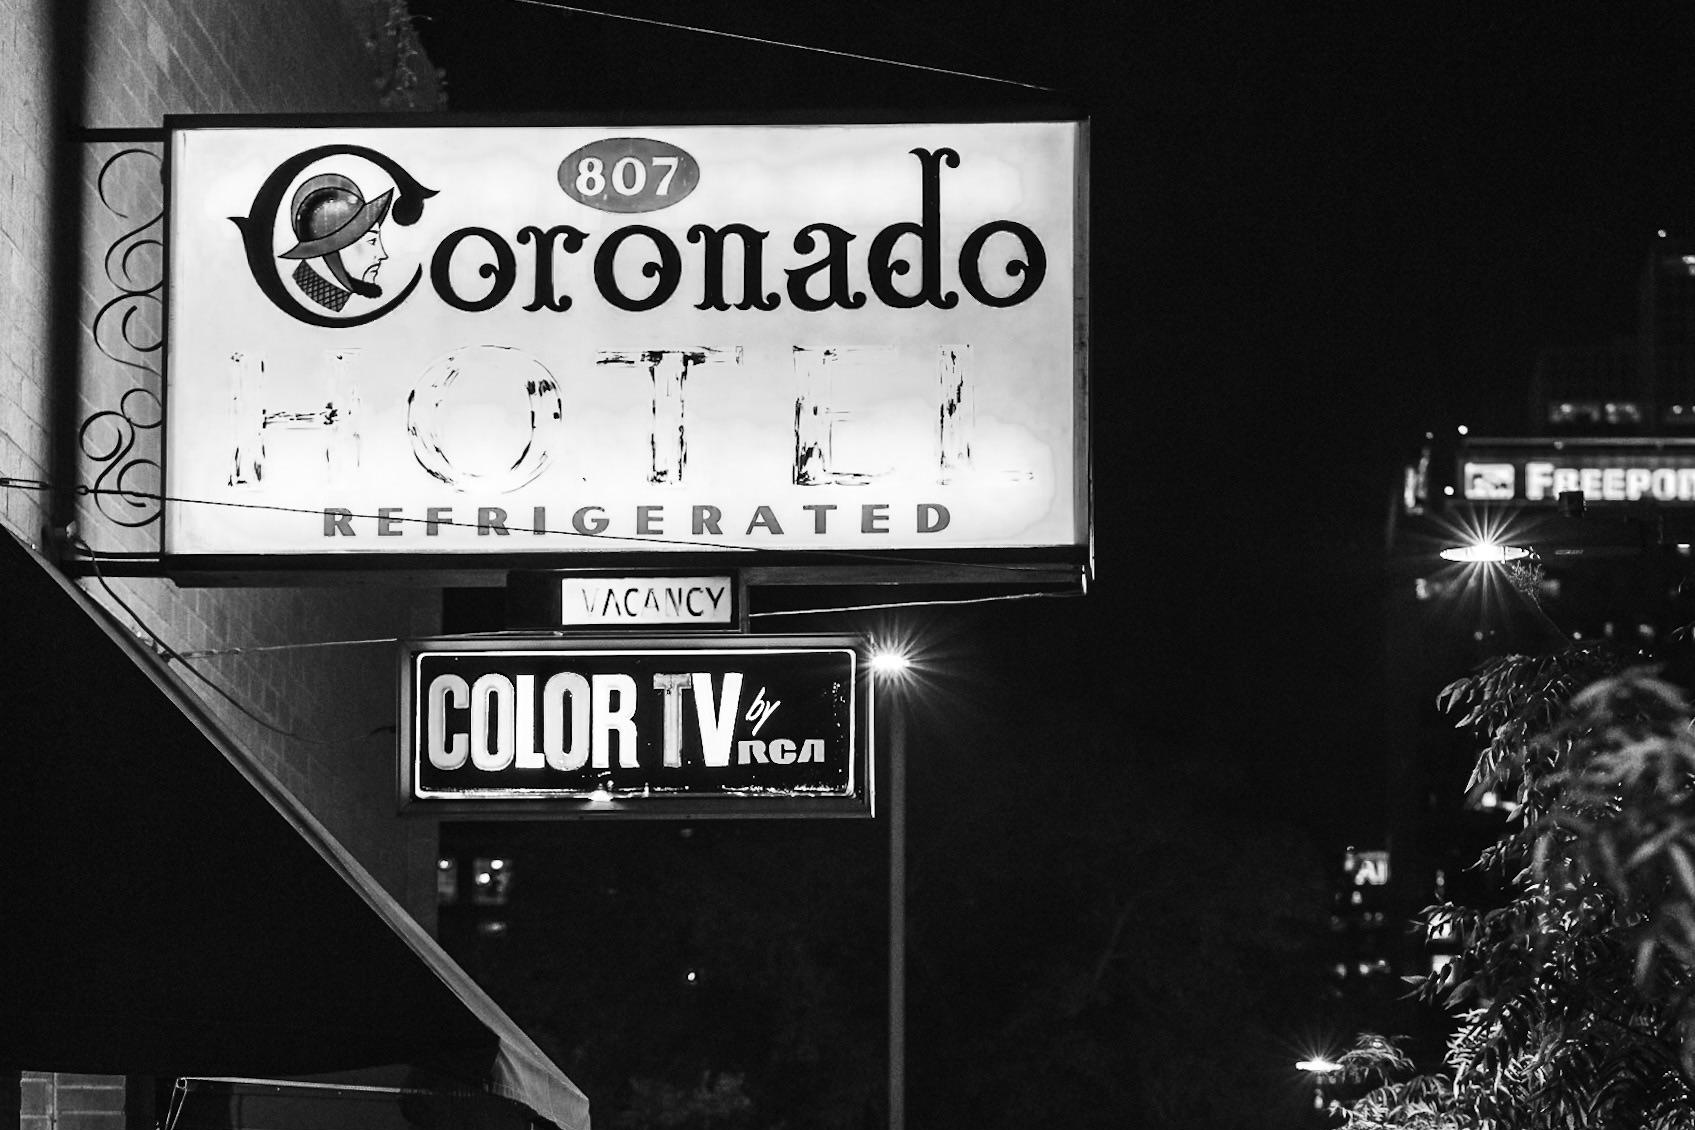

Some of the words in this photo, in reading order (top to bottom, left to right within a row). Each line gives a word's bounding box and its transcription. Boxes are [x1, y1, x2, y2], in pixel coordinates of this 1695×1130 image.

[574, 156, 676, 197] 807
[228, 144, 1047, 328] Coronado
[323, 503, 952, 538] REFRIGERATED
[582, 586, 726, 618] VACANCY
[427, 671, 640, 772] COLOR
[653, 672, 743, 769] TV
[745, 686, 781, 736] by
[737, 738, 825, 765] RCA
